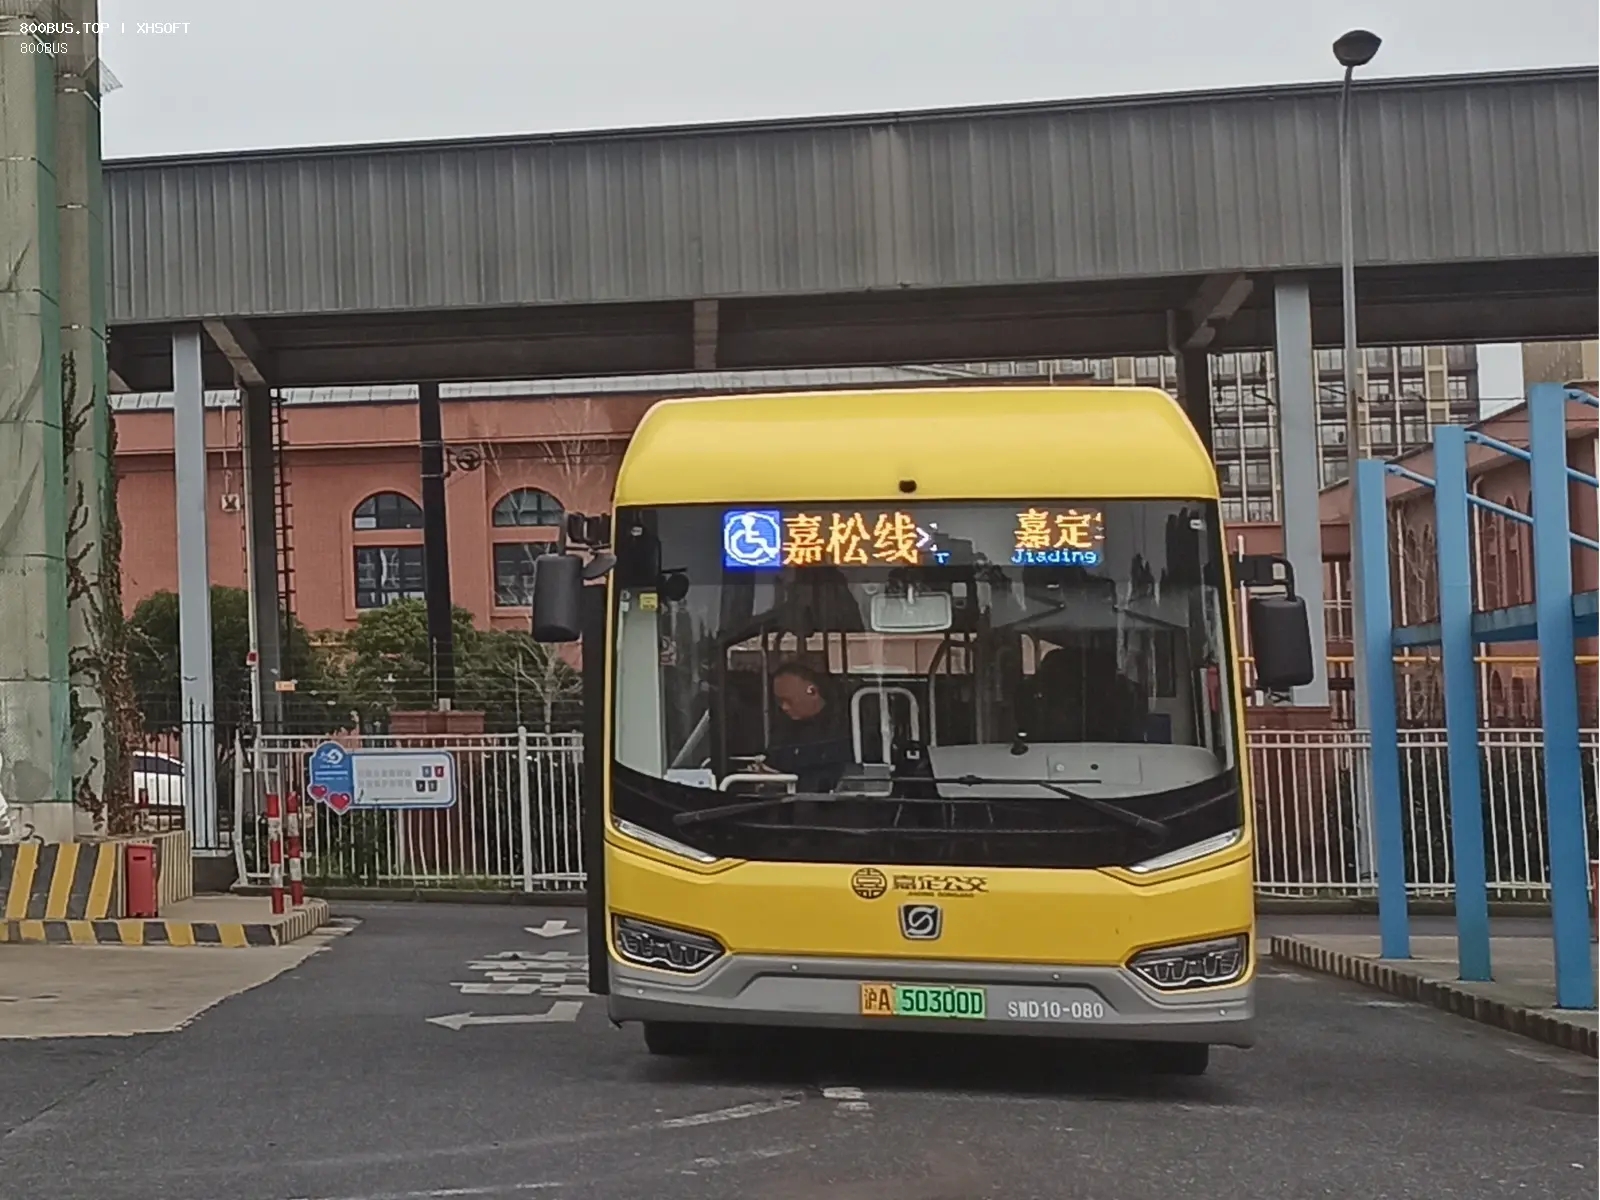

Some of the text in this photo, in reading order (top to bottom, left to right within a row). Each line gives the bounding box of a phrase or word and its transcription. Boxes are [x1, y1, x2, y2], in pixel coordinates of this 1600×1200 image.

[782, 511, 918, 565] 嘉松线
[1013, 508, 1104, 548] 嘉定
[1011, 548, 1097, 564] Jiading
[892, 874, 989, 893] 嘉定公交
[901, 988, 984, 1015] 50300D
[1007, 1000, 1105, 1020] SWD10-080
